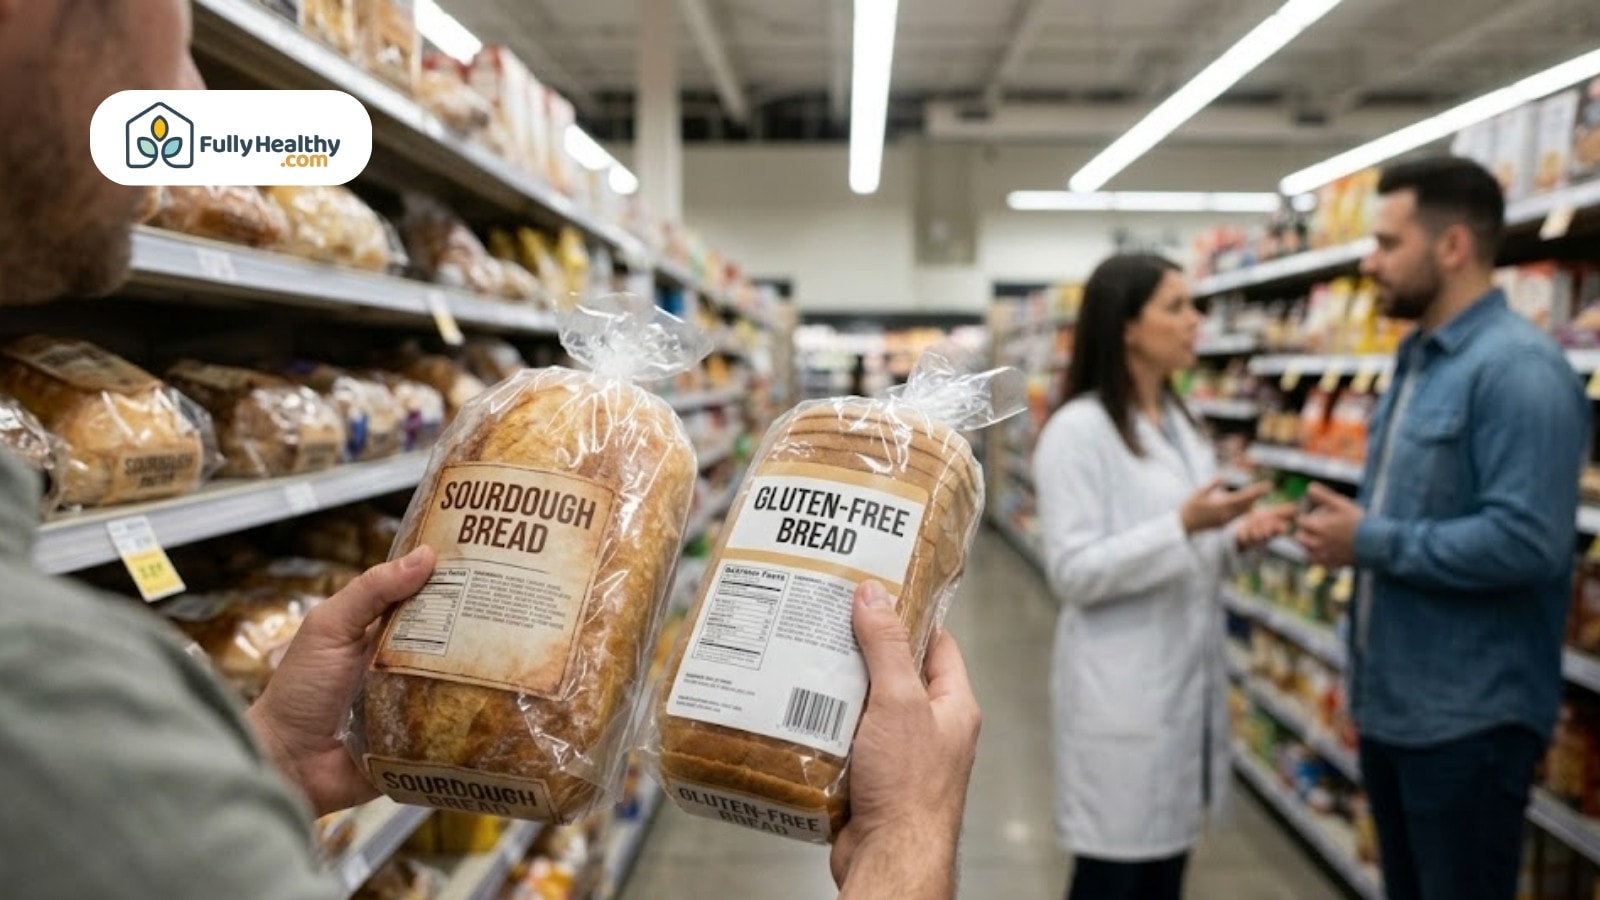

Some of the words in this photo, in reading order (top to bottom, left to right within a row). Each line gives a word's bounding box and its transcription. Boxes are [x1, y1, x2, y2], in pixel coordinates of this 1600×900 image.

[440, 480, 597, 530] SOURDOUGH
[753, 485, 911, 538] GLUTEN-FREE
[457, 514, 549, 554] BREAD
[775, 517, 858, 556] BREAD
[382, 771, 538, 807] SOURDOUGH
[678, 787, 821, 832] GLUTEN-FREE
